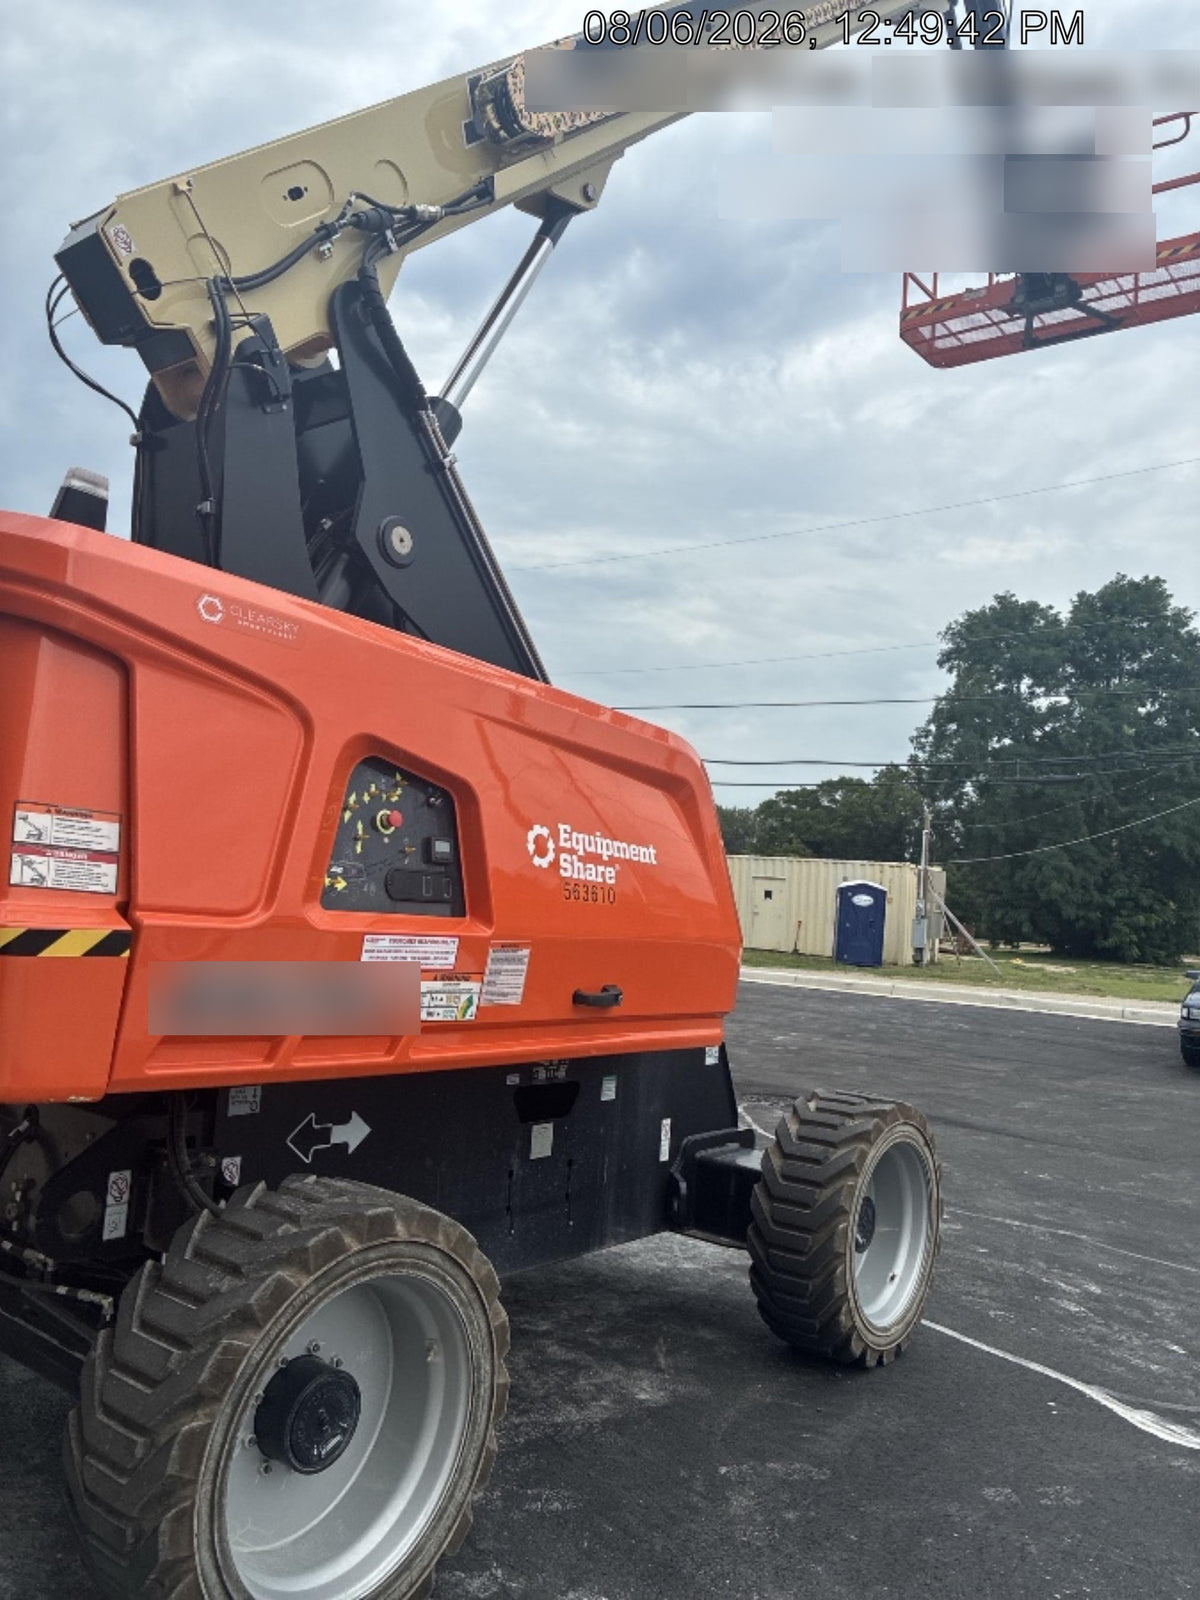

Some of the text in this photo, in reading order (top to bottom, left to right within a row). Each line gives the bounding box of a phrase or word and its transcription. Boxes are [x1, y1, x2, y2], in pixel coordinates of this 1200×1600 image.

[229, 605, 299, 633] CLEARSKY
[557, 822, 657, 865] Equipment
[563, 882, 617, 905] 563610
